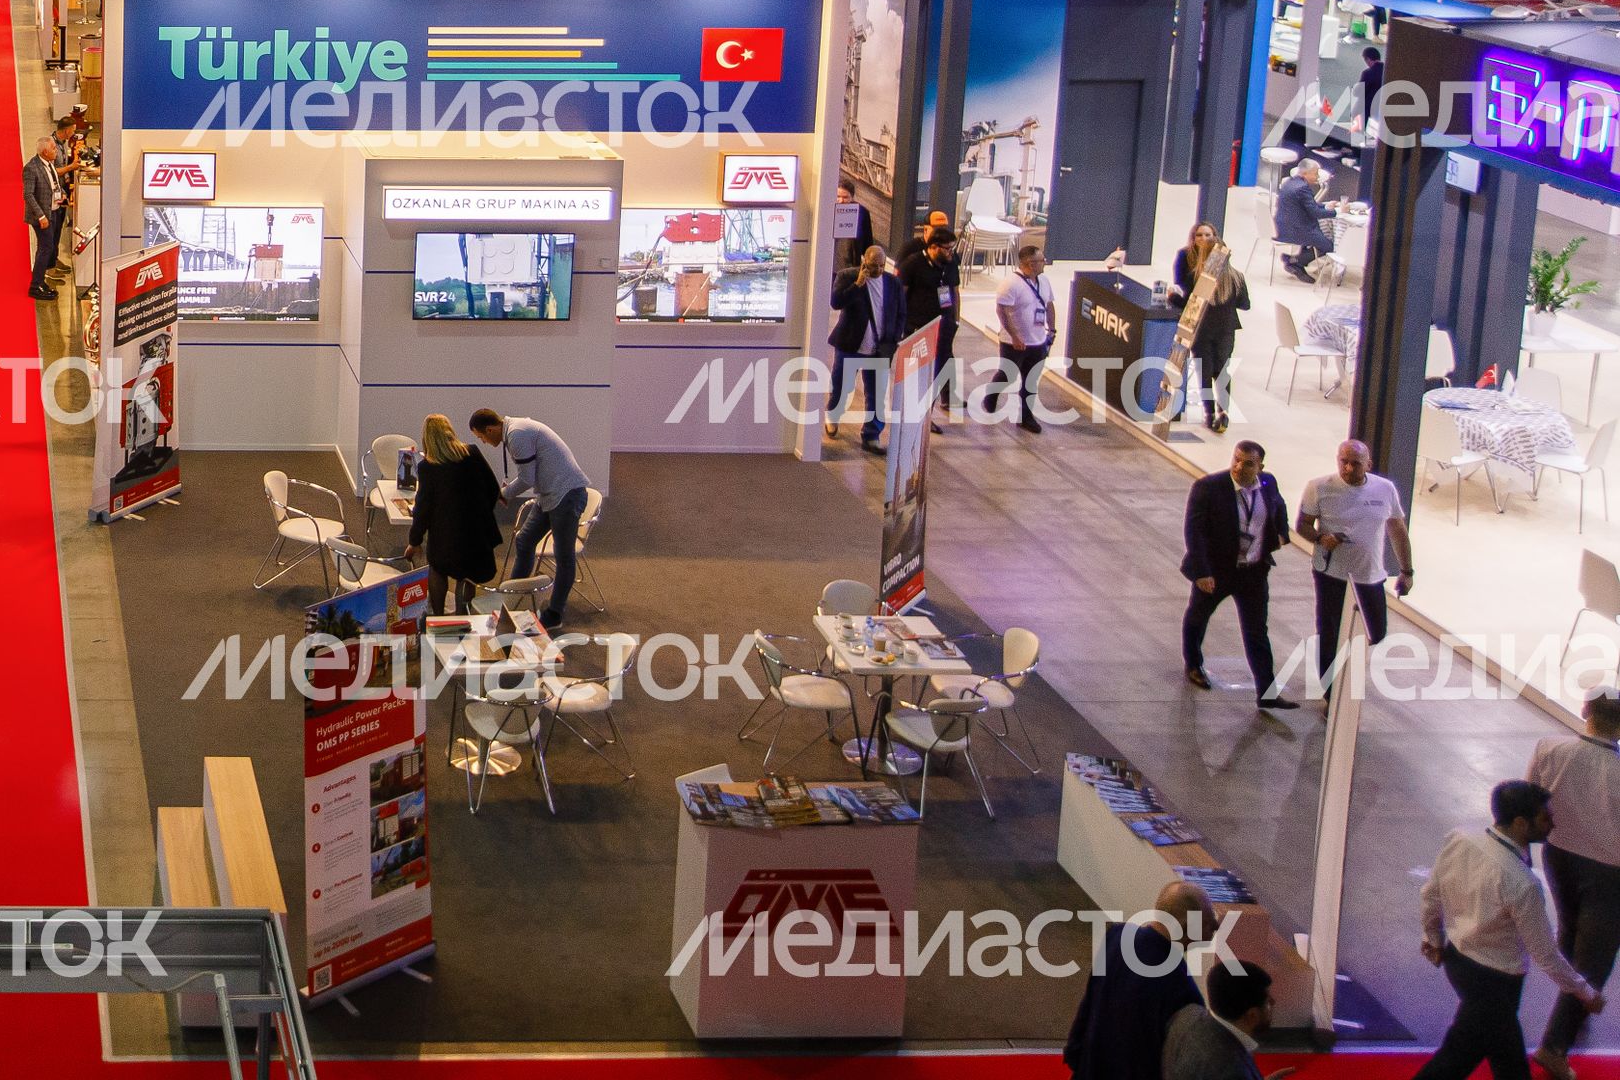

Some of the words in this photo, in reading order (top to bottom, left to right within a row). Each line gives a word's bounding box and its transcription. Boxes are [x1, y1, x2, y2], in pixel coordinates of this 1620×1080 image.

[159, 25, 408, 94] Türkiye
[392, 198, 471, 209] OZKANLAR
[476, 199, 517, 209] GRUP
[521, 199, 577, 210] MAKINA
[581, 199, 600, 210] AS
[118, 302, 141, 317] Effective
[141, 293, 161, 308] solution
[118, 315, 136, 329] driving
[128, 322, 146, 335] limited
[146, 316, 163, 328] access
[1080, 297, 1131, 343] E-MAK
[882, 553, 920, 594] COMPACTION
[883, 552, 902, 576] VIBRO
[316, 714, 354, 737] Hydraulic
[355, 706, 381, 722] Power
[382, 697, 407, 713] Packs
[316, 737, 338, 752] OMS
[339, 732, 350, 744] PP
[351, 720, 380, 739] SERIES
[323, 775, 357, 793] Advantages
